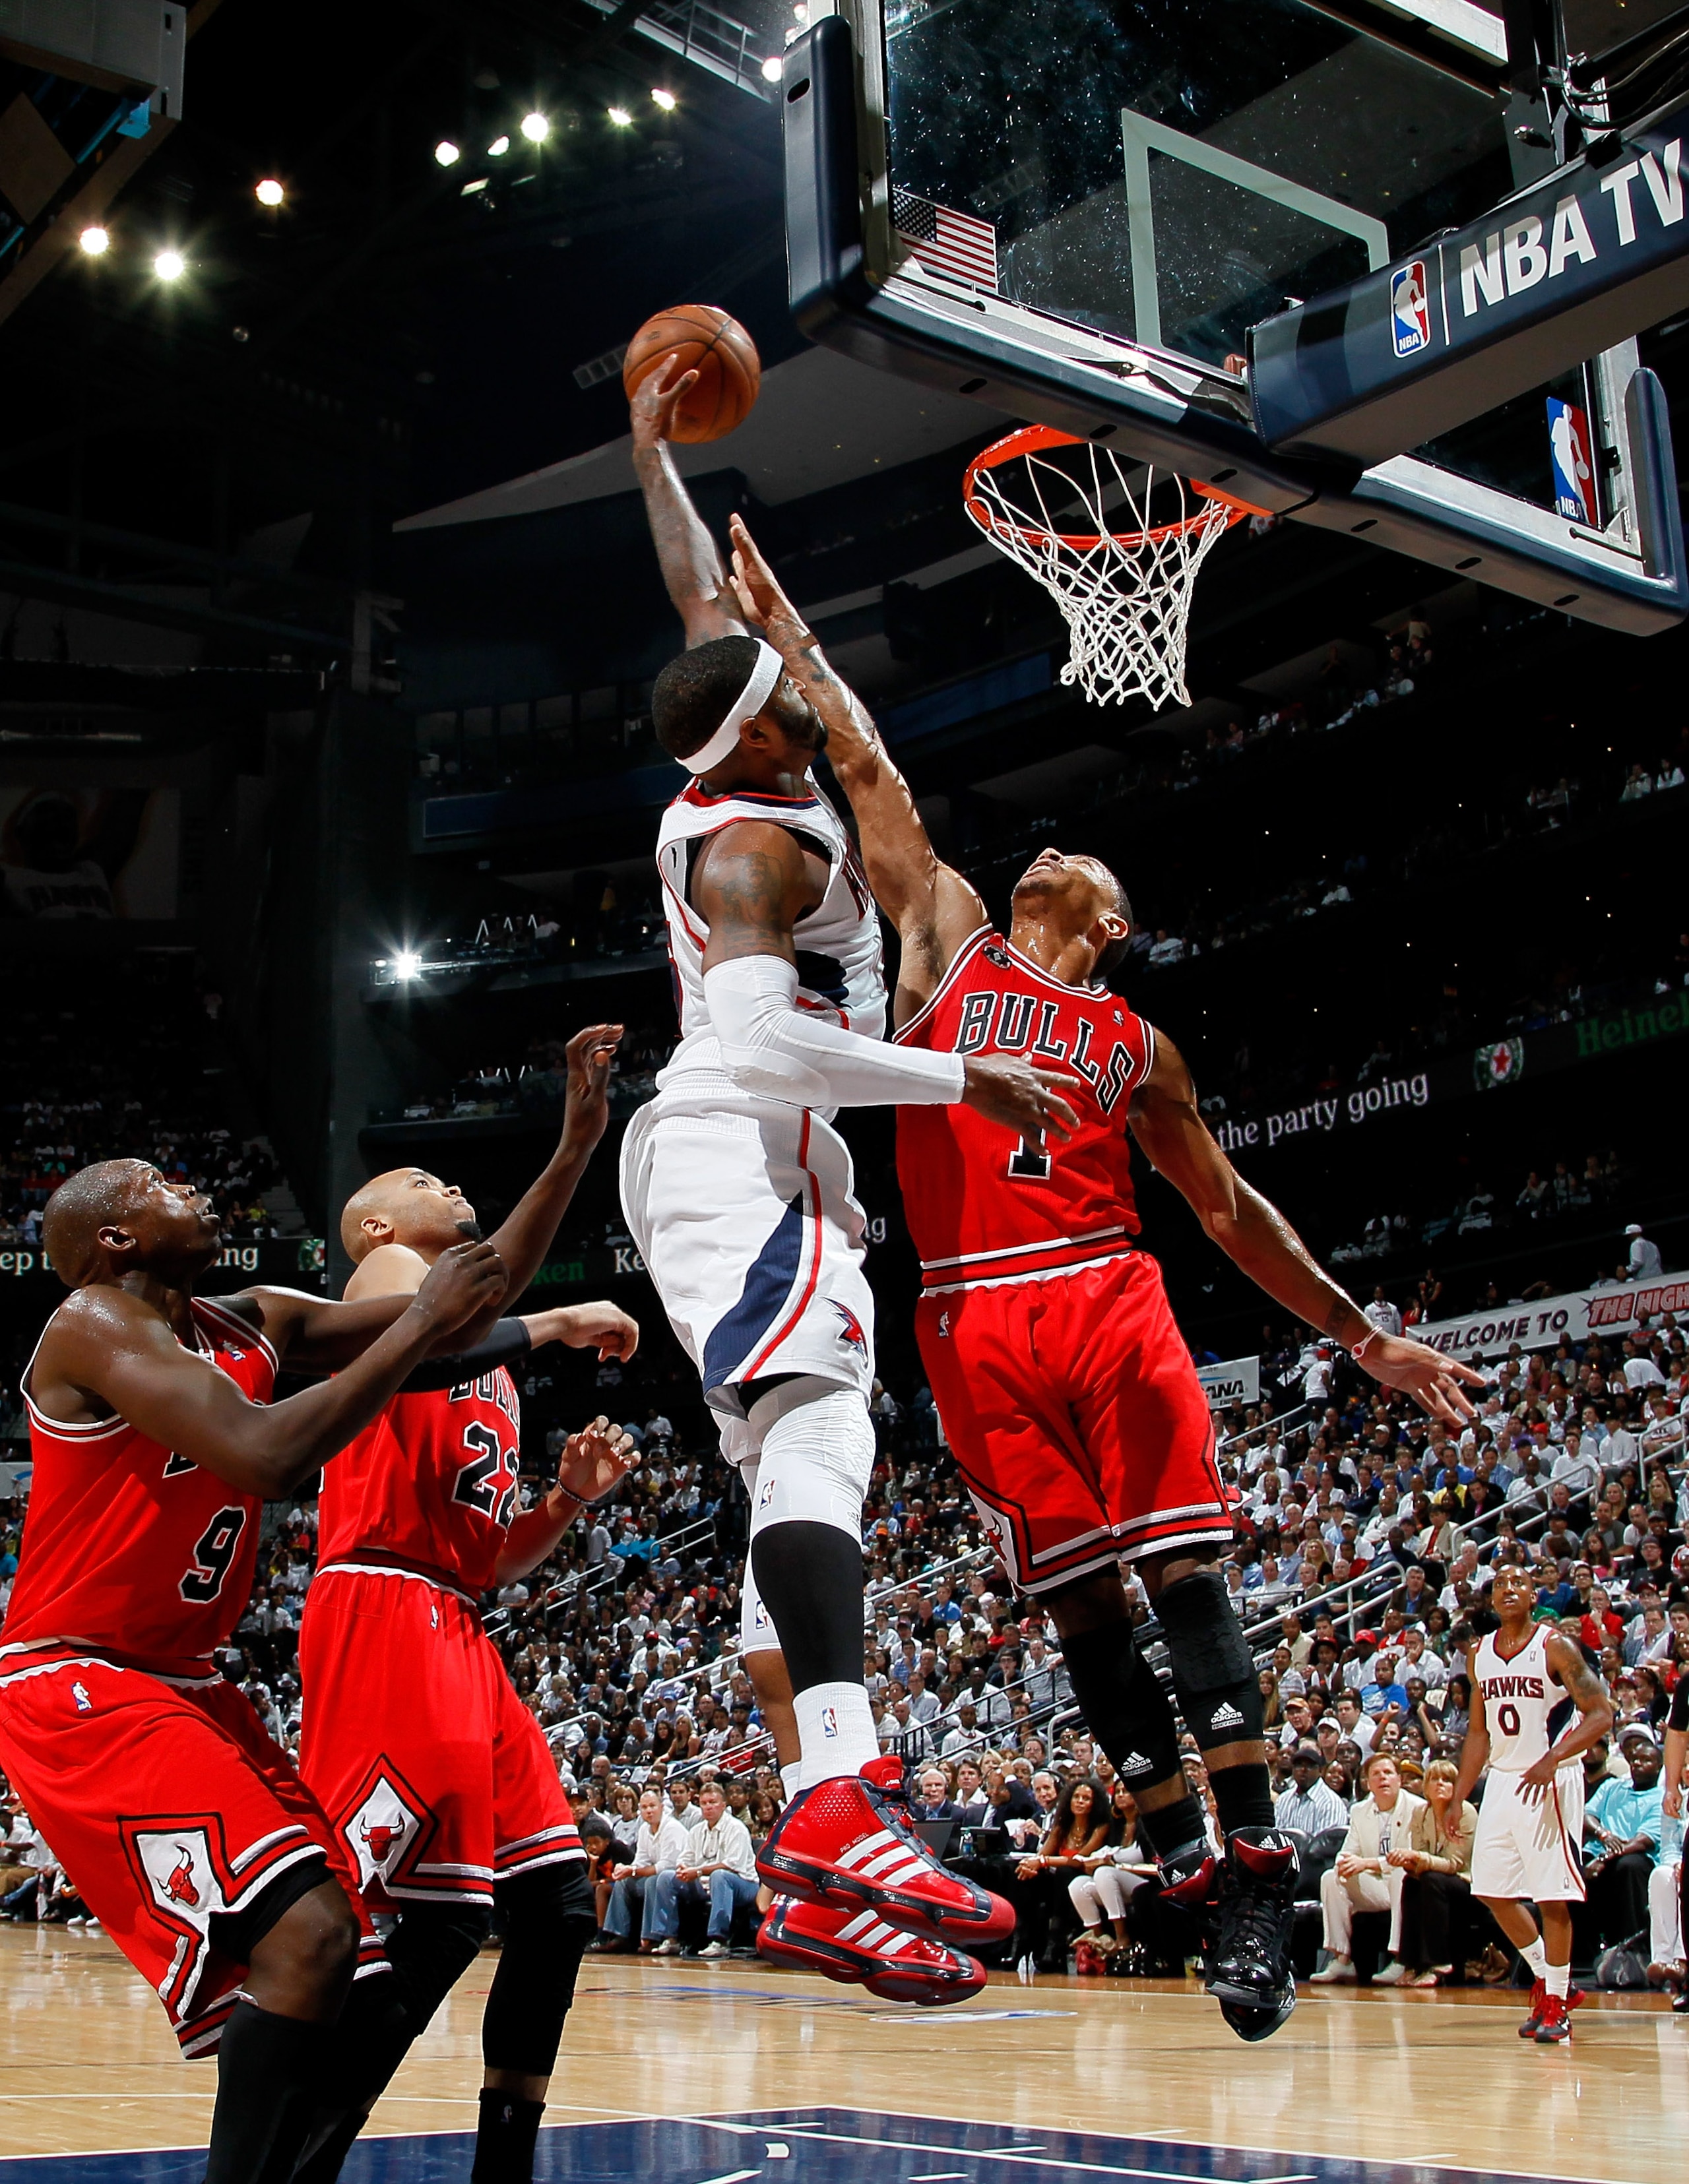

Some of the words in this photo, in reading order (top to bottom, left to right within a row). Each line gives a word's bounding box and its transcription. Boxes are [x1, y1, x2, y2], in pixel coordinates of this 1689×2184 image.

[1459, 193, 1597, 318] NBA
[1599, 137, 1684, 247] TV
[1398, 332, 1420, 352] NBA
[952, 990, 1135, 1116] BULLS
[1217, 1119, 1259, 1152] the
[1266, 1098, 1339, 1148] party
[1347, 1073, 1429, 1123] going
[1418, 1315, 1531, 1353] WELCOME
[1536, 1309, 1568, 1336] TO
[1587, 1292, 1635, 1328] THE
[177, 1505, 247, 1605] 9
[1479, 1676, 1545, 1700] HAWKS
[1498, 1704, 1521, 1736] 0
